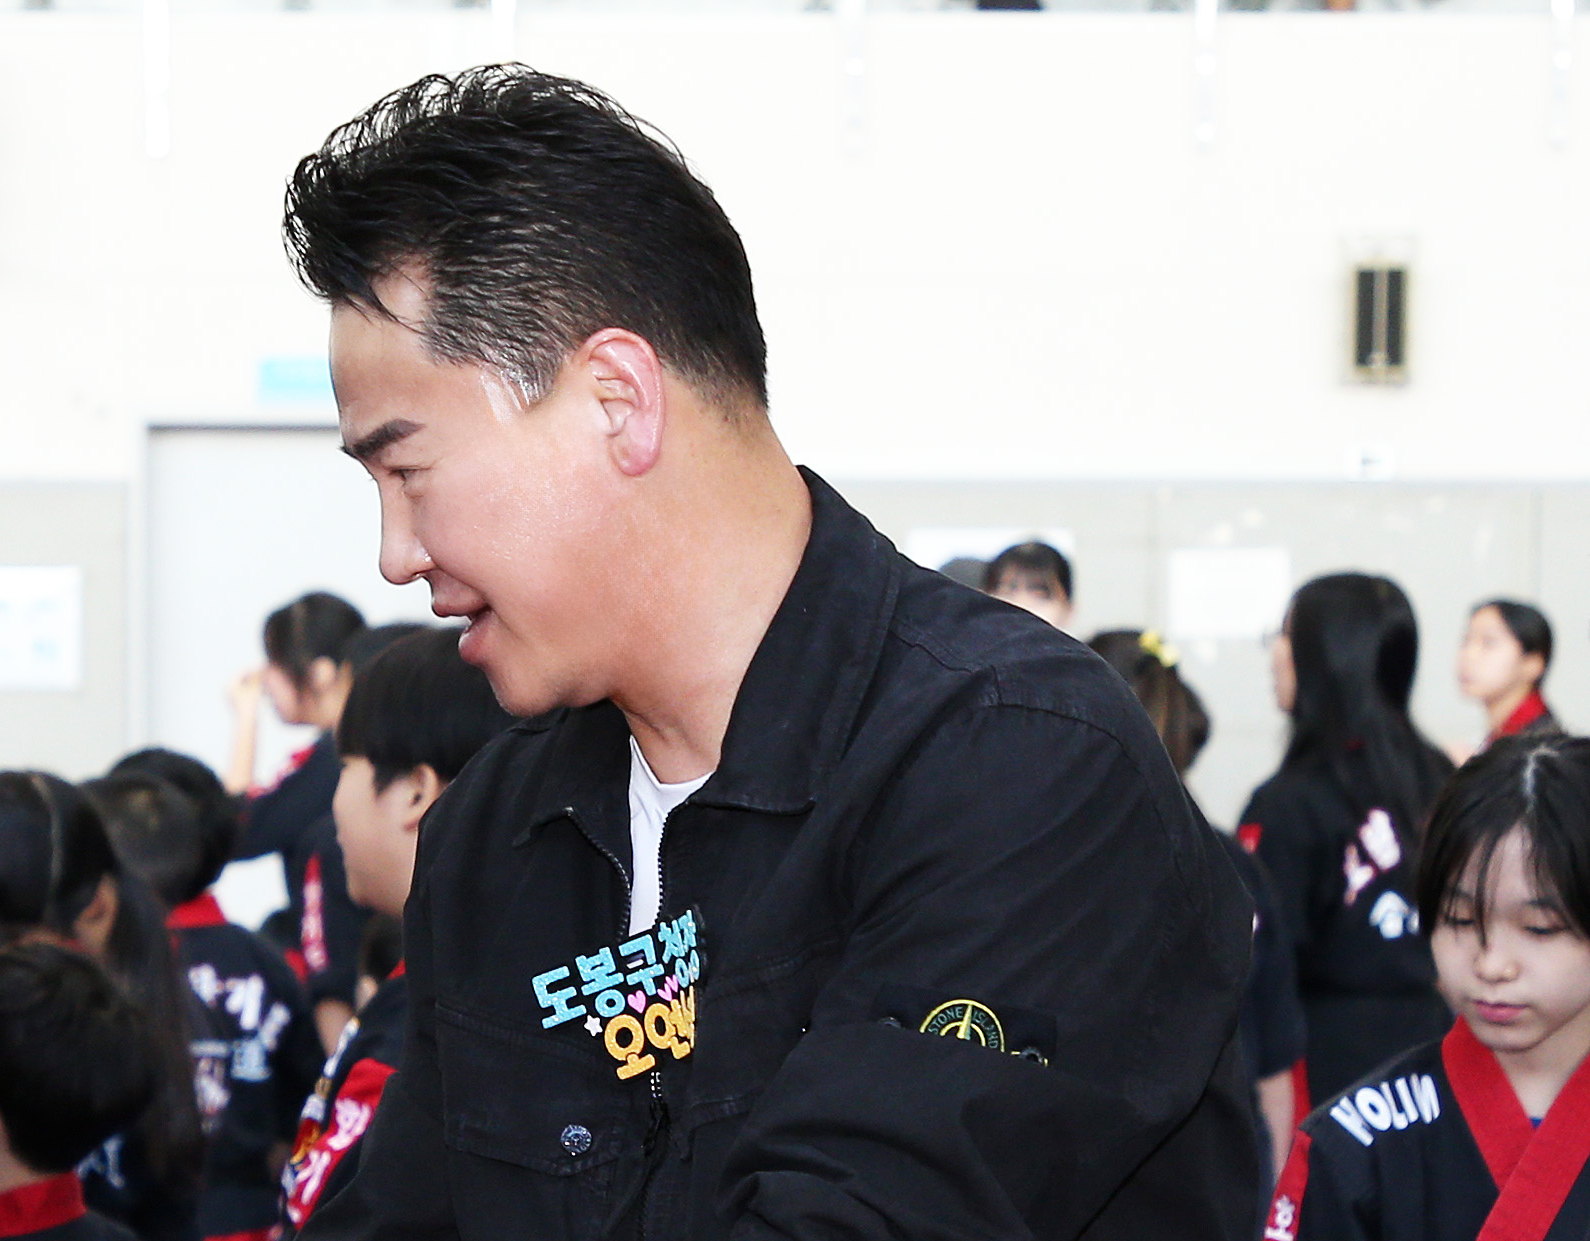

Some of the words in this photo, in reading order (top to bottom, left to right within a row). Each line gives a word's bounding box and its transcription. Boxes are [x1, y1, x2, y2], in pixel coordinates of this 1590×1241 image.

[531, 909, 700, 1029] 도봉구청장
[928, 1006, 964, 1036] STONE
[971, 1010, 1000, 1050] ISLAND
[286, 1098, 372, 1224] 합기
